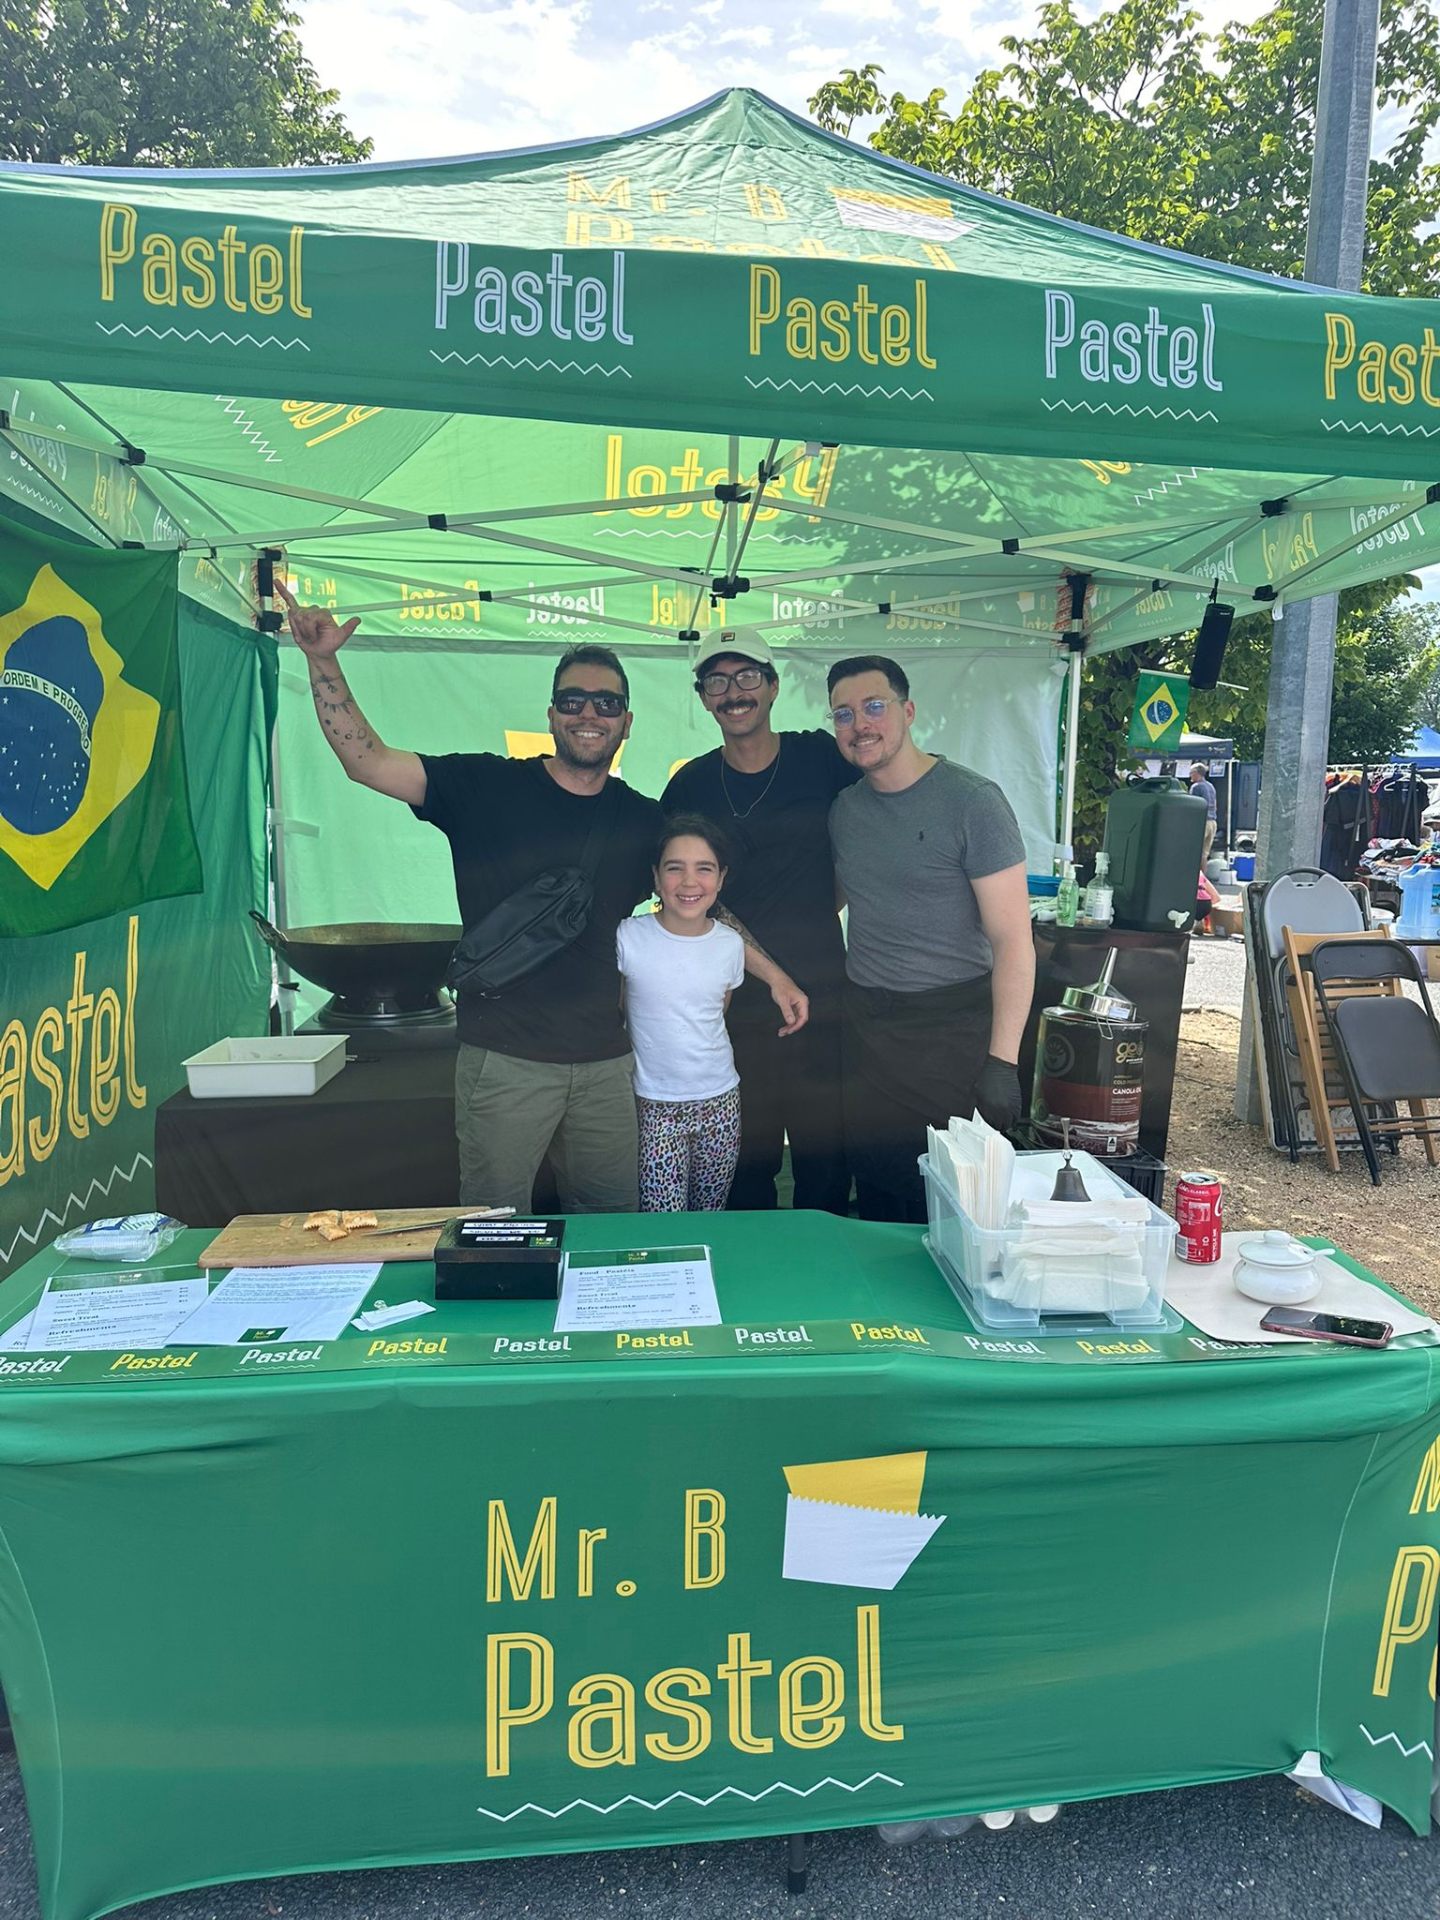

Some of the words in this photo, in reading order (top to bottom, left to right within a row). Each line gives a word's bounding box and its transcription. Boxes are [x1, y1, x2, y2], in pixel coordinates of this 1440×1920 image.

[743, 183, 789, 222] B
[100, 202, 312, 318] Pastel
[435, 240, 634, 345] Pastel
[748, 263, 937, 369] Pastel
[1044, 288, 1222, 392] Pastel
[4, 672, 39, 690] ORDEM
[42, 682, 49, 695] E
[53, 687, 89, 750] PROGREO
[493, 1336, 572, 1353] Pastel
[616, 1331, 694, 1349] Pastel
[734, 1325, 813, 1344] Pastel
[850, 1323, 931, 1345] Pastel
[963, 1335, 1046, 1355] Pastel
[239, 1345, 324, 1365] Pastel
[367, 1337, 448, 1356] Pastel
[1075, 1339, 1162, 1356] Pastel
[110, 1352, 199, 1371] Pastel
[486, 1496, 637, 1602] Mr.
[684, 1488, 726, 1590] B
[486, 1604, 905, 1777] Pastel
